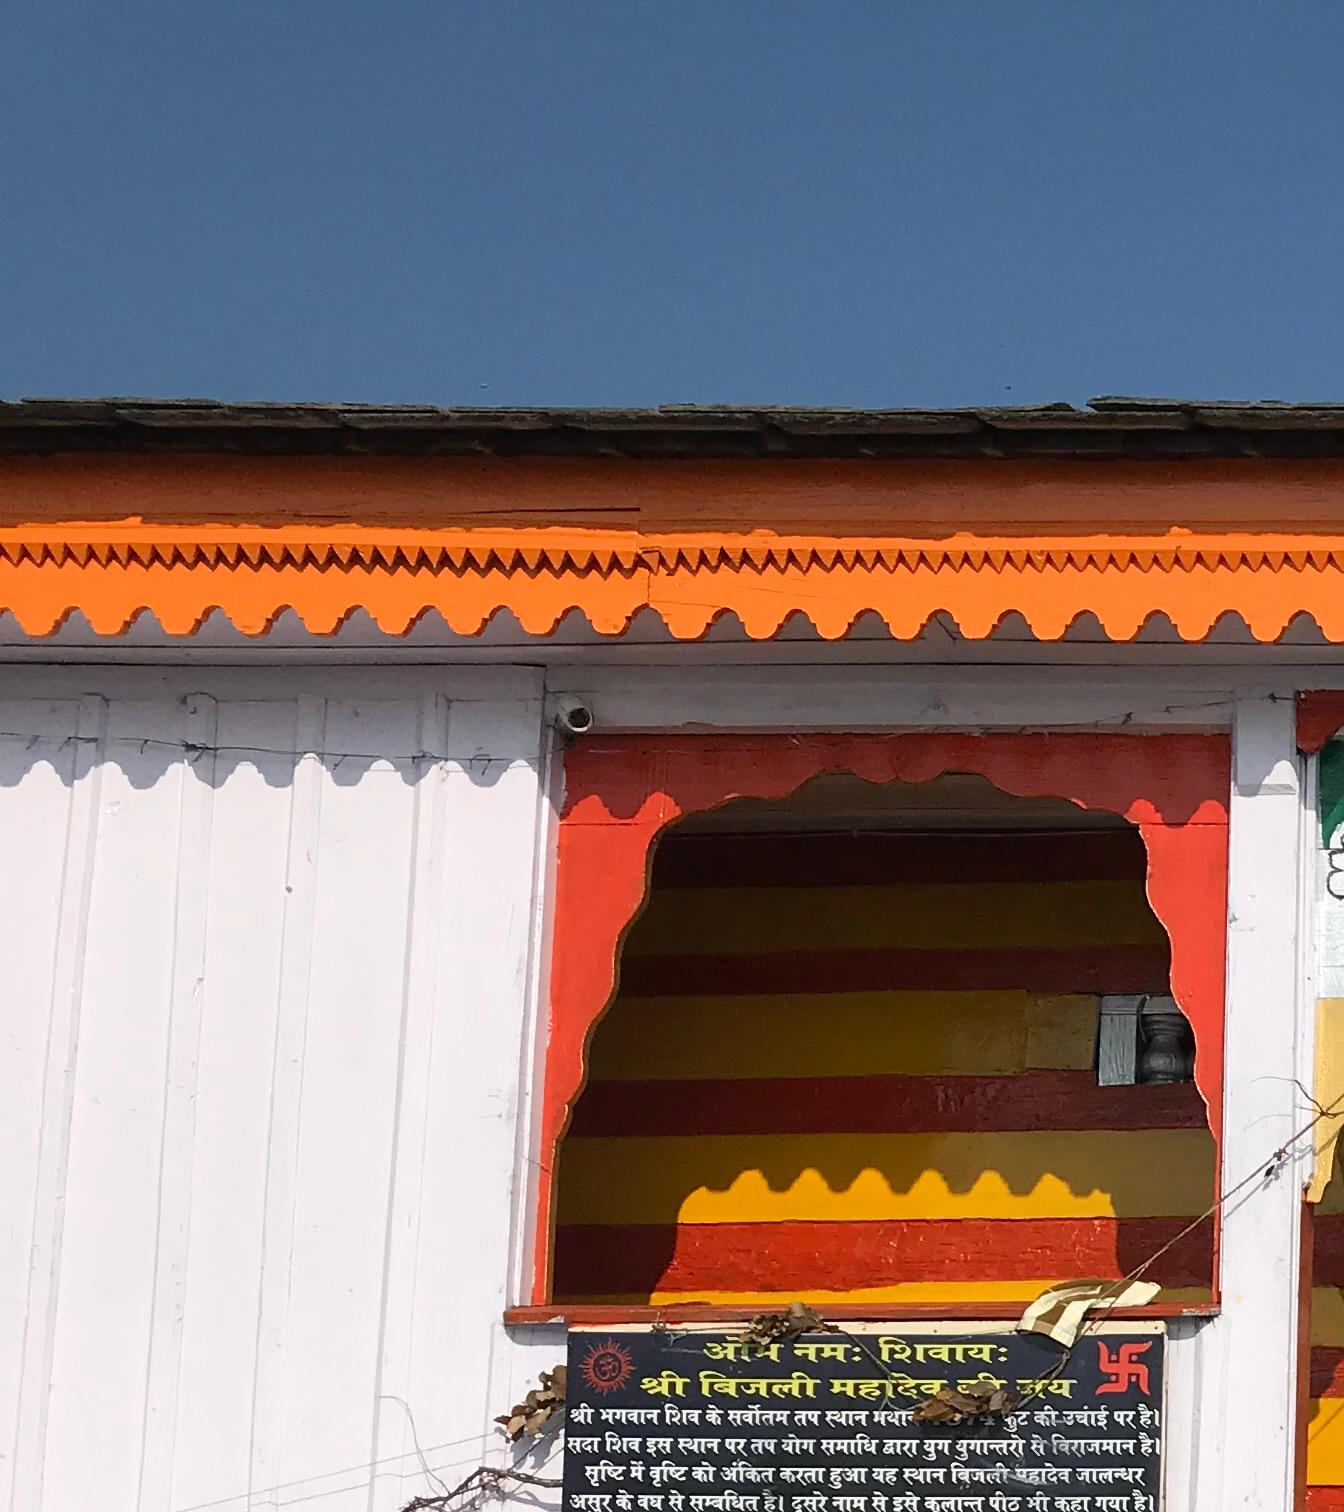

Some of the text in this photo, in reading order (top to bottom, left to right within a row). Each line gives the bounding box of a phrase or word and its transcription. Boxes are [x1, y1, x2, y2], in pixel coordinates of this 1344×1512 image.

[793, 1343, 861, 1363] नमः
[878, 1337, 1008, 1363] शिवायः
[640, 1370, 690, 1397] श्री
[700, 1370, 821, 1398] बिजली
[829, 1372, 948, 1400] महादेव
[569, 1403, 594, 1425] श्री
[600, 1409, 660, 1426] भगवान
[664, 1403, 702, 1426] शिव
[705, 1404, 724, 1426] के
[727, 1404, 793, 1427] सर्वोतम
[794, 1410, 822, 1426] तप
[825, 1410, 870, 1427] स्थान
[1034, 1405, 1057, 1426] की
[1113, 1410, 1136, 1429] पर
[1139, 1403, 1160, 1427] है।
[568, 1438, 601, 1454] सदा
[605, 1432, 642, 1453] शिव
[646, 1438, 674, 1457] इस
[678, 1438, 721, 1455] स्थान
[725, 1439, 747, 1456] पर
[751, 1439, 778, 1454] तप
[782, 1434, 816, 1454] योग
[821, 1434, 879, 1456] समाधि
[883, 1440, 920, 1457] द्वारा
[924, 1440, 952, 1460] युग
[1030, 1434, 1048, 1456] से
[1052, 1434, 1137, 1457] विराजमान
[1138, 1432, 1160, 1456] है।
[585, 1460, 1144, 1489] सृष्टि में वृष्टि को अंकित करता हुआ यह स्थान बिजली महादेव जालन्धर
[616, 1489, 634, 1510] के
[668, 1490, 685, 1512] से
[762, 1489, 783, 1512] है।
[832, 1497, 868, 1512] नाम
[872, 1491, 888, 1512] से
[989, 1491, 1022, 1512] पीठ
[1026, 1491, 1050, 1512] भी
[1095, 1497, 1130, 1512] गया
